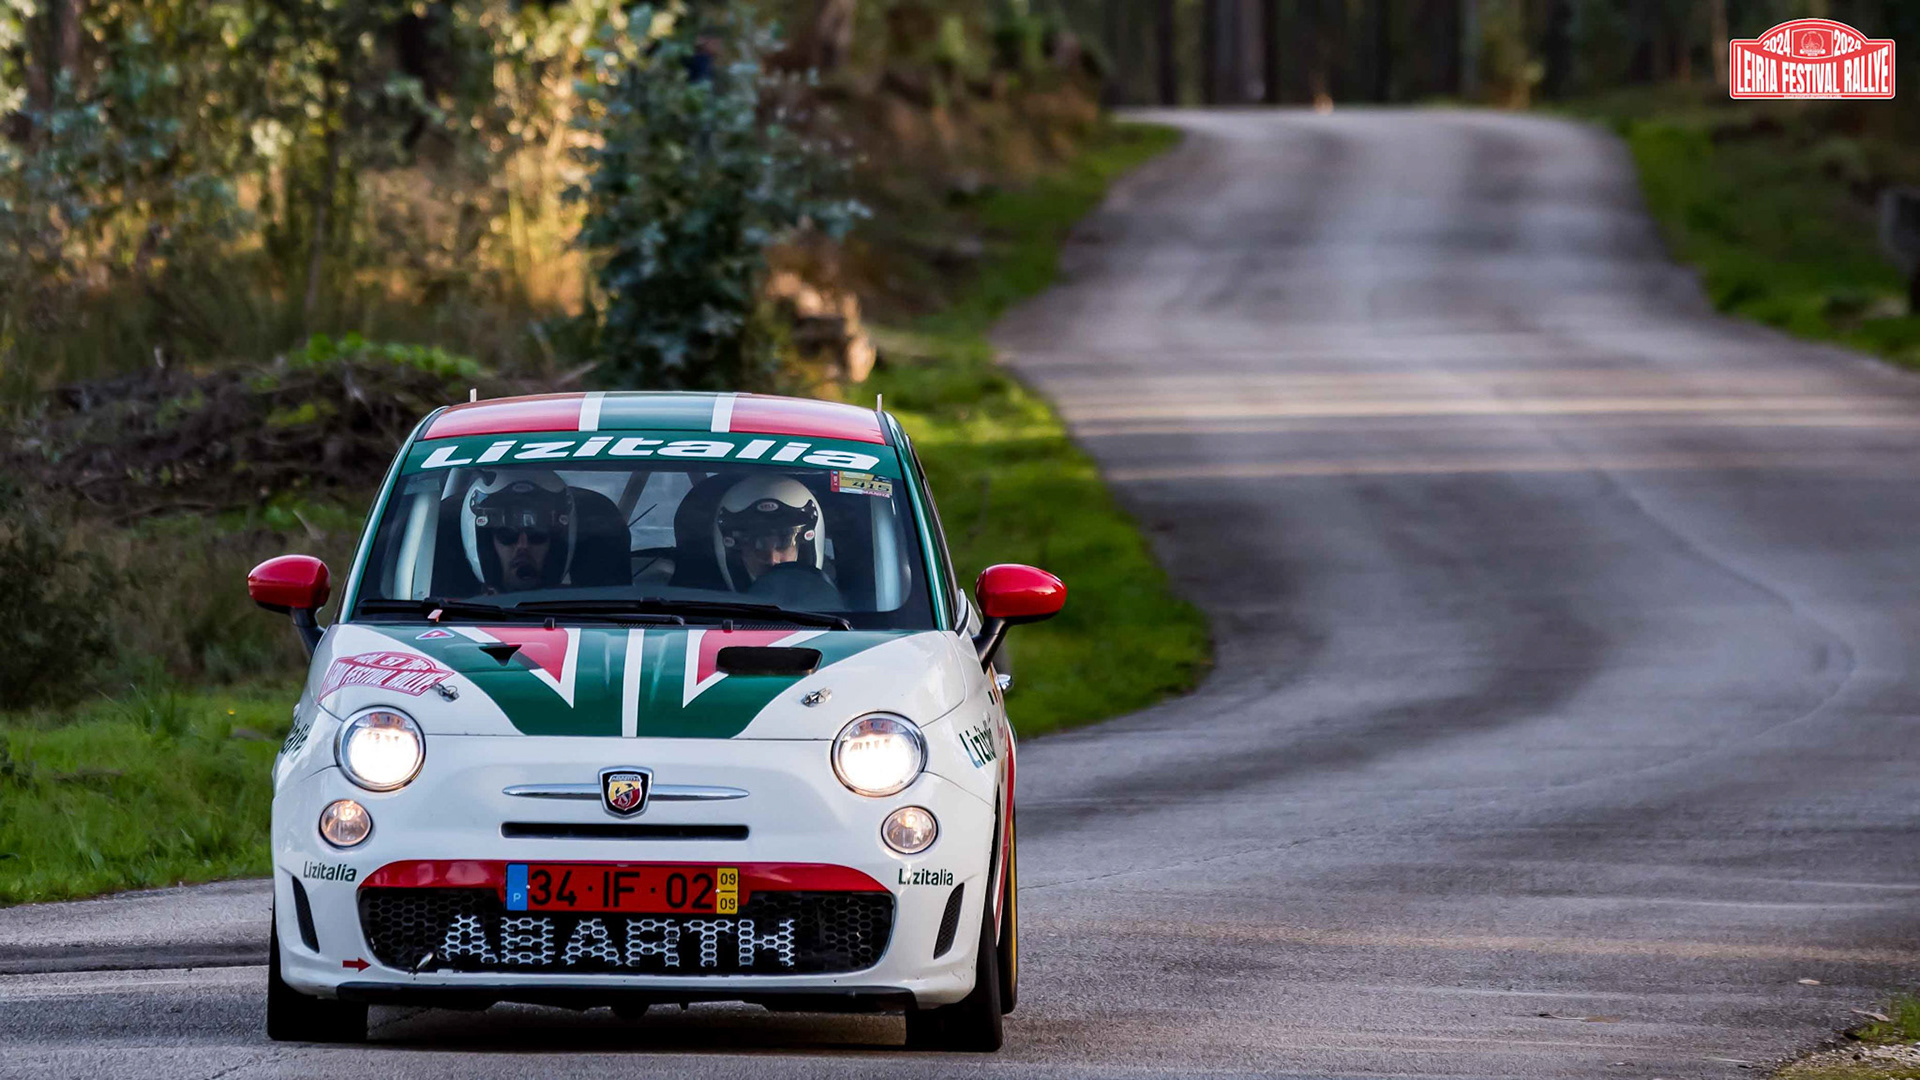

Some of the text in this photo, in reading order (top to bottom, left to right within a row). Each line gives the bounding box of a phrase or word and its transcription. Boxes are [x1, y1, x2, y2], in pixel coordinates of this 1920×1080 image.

[420, 436, 881, 471] Lizitalia
[303, 861, 357, 882] Lizitalia
[720, 873, 736, 885] 09
[513, 892, 521, 902] P
[720, 898, 736, 911] 09
[437, 914, 795, 967] ABARTH
